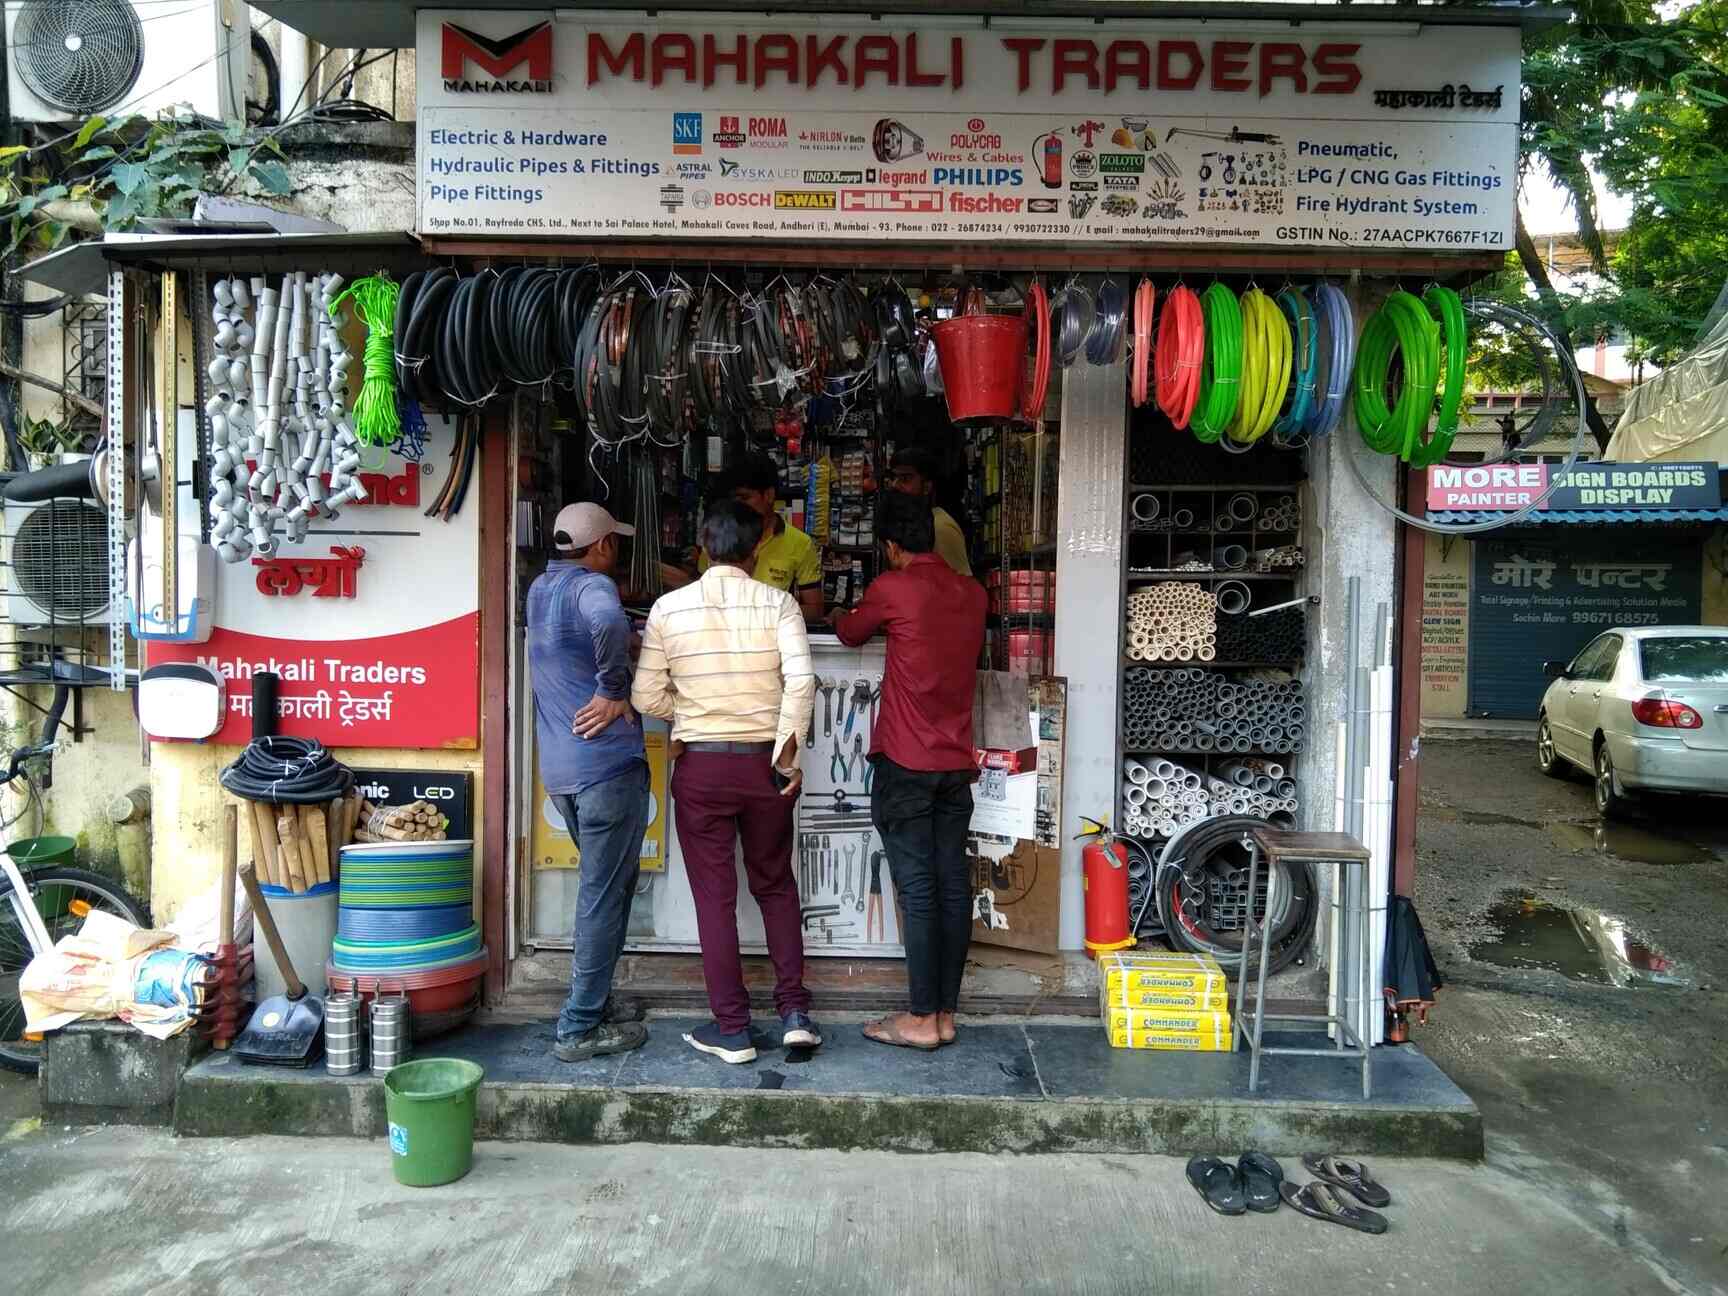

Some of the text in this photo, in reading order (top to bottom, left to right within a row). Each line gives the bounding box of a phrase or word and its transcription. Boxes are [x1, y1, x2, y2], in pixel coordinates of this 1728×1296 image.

[586, 31, 1363, 98] MAHAKALI TRADERS
[444, 80, 552, 94] MAHAKALI
[1374, 84, 1456, 109] महाकाली
[749, 118, 787, 137] ROMA
[430, 130, 607, 146] Electric & Hardware
[951, 134, 1000, 148] POLYCAB
[927, 152, 1024, 163] Wires & Cables
[1298, 140, 1398, 160] Pneumatic,
[430, 157, 660, 177] Hydraulic Pipes & Fittings
[676, 163, 712, 172] ASTRAL
[1101, 155, 1143, 166] ZOLOTO
[680, 172, 706, 180] PIPES
[879, 169, 927, 187] legrand
[934, 168, 1023, 185] PHILIPS
[1105, 176, 1137, 184] TATA
[1297, 168, 1501, 191] LPG / CNG Gas Fittings
[430, 185, 543, 204] Pipe Fittings
[714, 193, 771, 206] BOSCH
[949, 192, 1024, 213] fischer
[1296, 196, 1478, 217] Fire Hydrant System
[430, 218, 450, 228] Shop
[571, 218, 591, 228] Next
[594, 219, 603, 228] to
[605, 219, 618, 228] Sai
[622, 219, 650, 229] Palace
[682, 219, 722, 230] Mahakali
[726, 220, 749, 230] Caves
[753, 220, 777, 231] Road,
[781, 220, 814, 231] Andheri
[834, 221, 869, 232] Mumbai
[896, 222, 922, 232] Phone
[931, 223, 948, 233] 022
[1276, 227, 1323, 241] GSTIN
[1433, 467, 1541, 489] MORE
[1552, 470, 1706, 488] SIGN BOARDS
[1447, 492, 1531, 505] PAINTER
[1580, 488, 1673, 505] DISPLAY
[324, 658, 426, 685] Traders
[338, 690, 392, 727] ट्रेडर्स
[414, 786, 455, 800] LED
[1144, 1018, 1198, 1028] COMMANDER
[1145, 1036, 1200, 1045] COMMANDER
